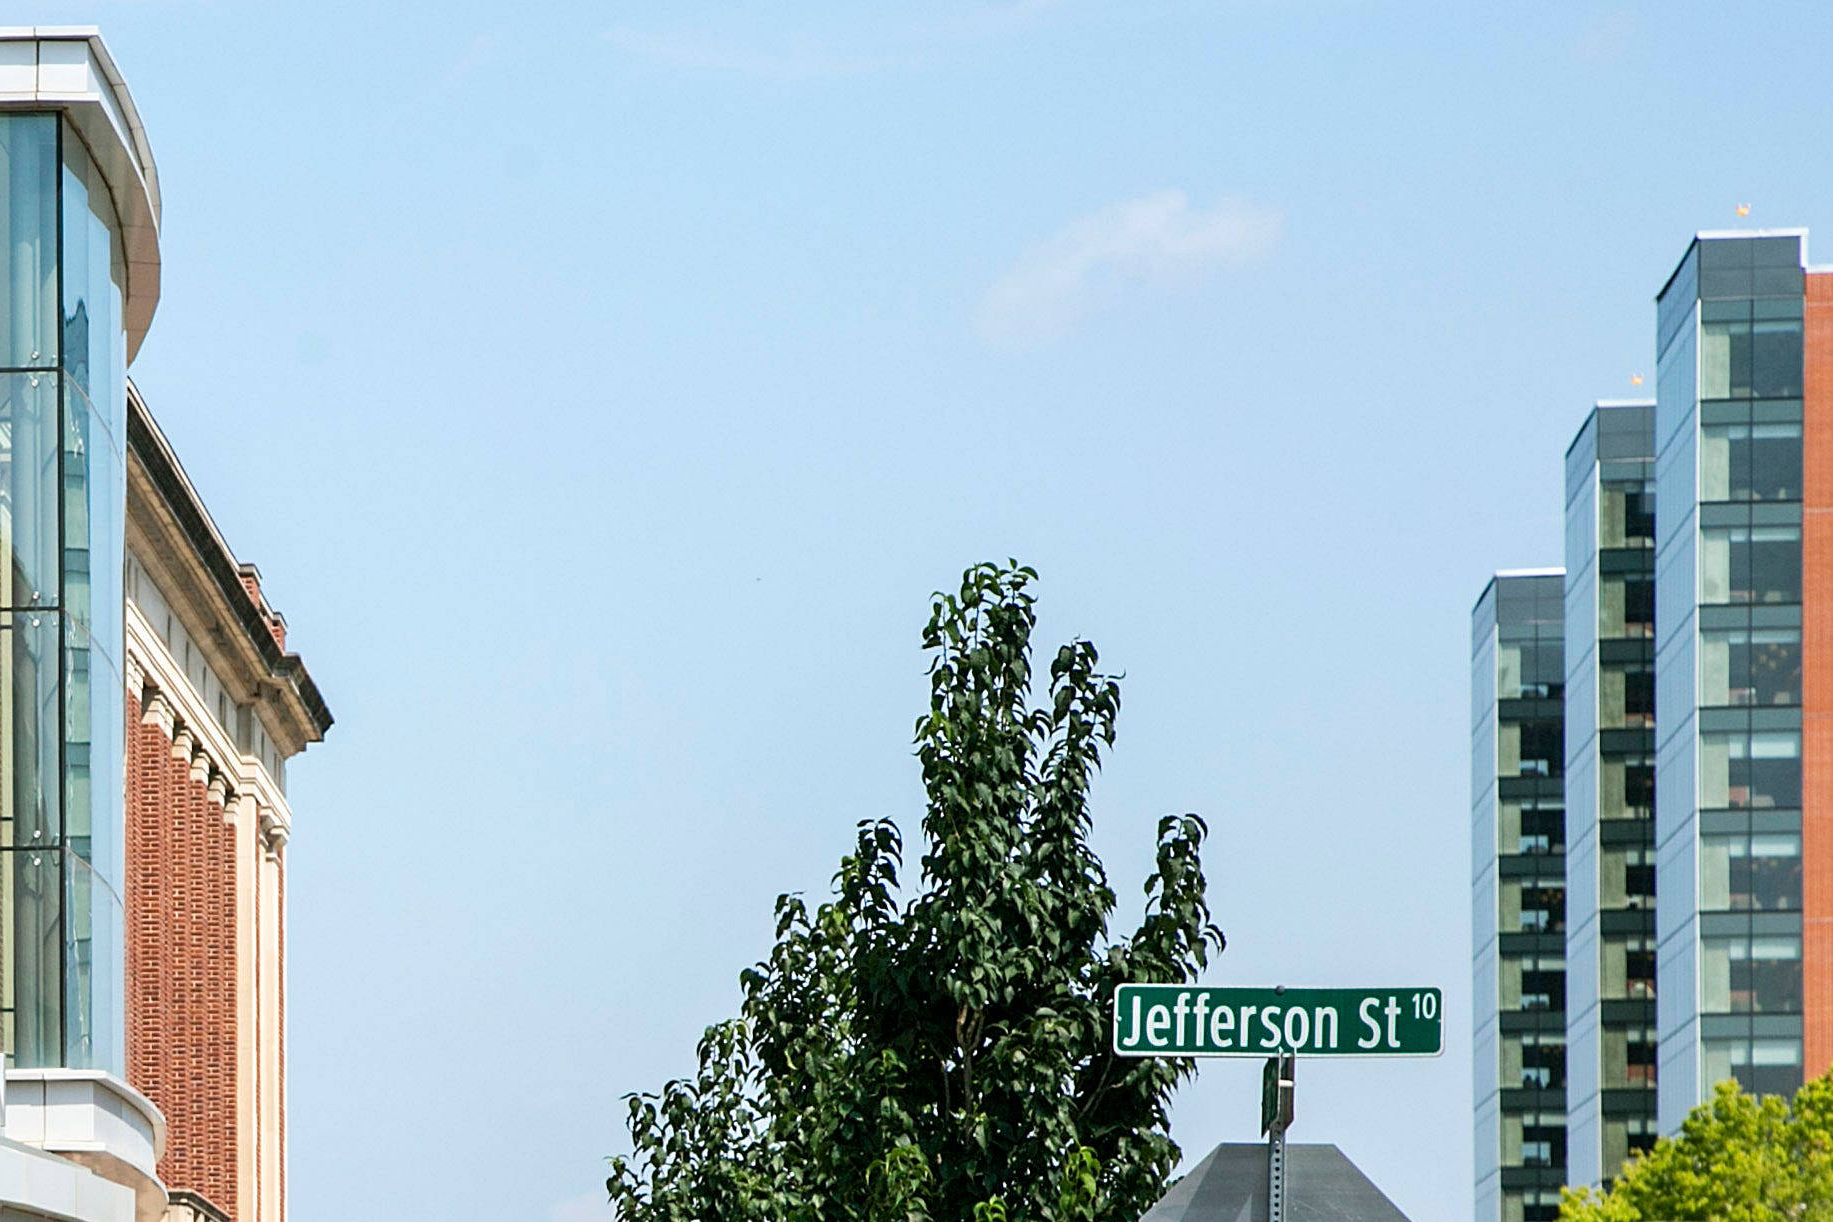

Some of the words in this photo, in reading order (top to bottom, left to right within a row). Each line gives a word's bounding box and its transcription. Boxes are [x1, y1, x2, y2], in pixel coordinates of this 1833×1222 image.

[1122, 991, 1339, 1049] Jefferson
[1357, 996, 1402, 1049] St
[1412, 992, 1437, 1020] 10
